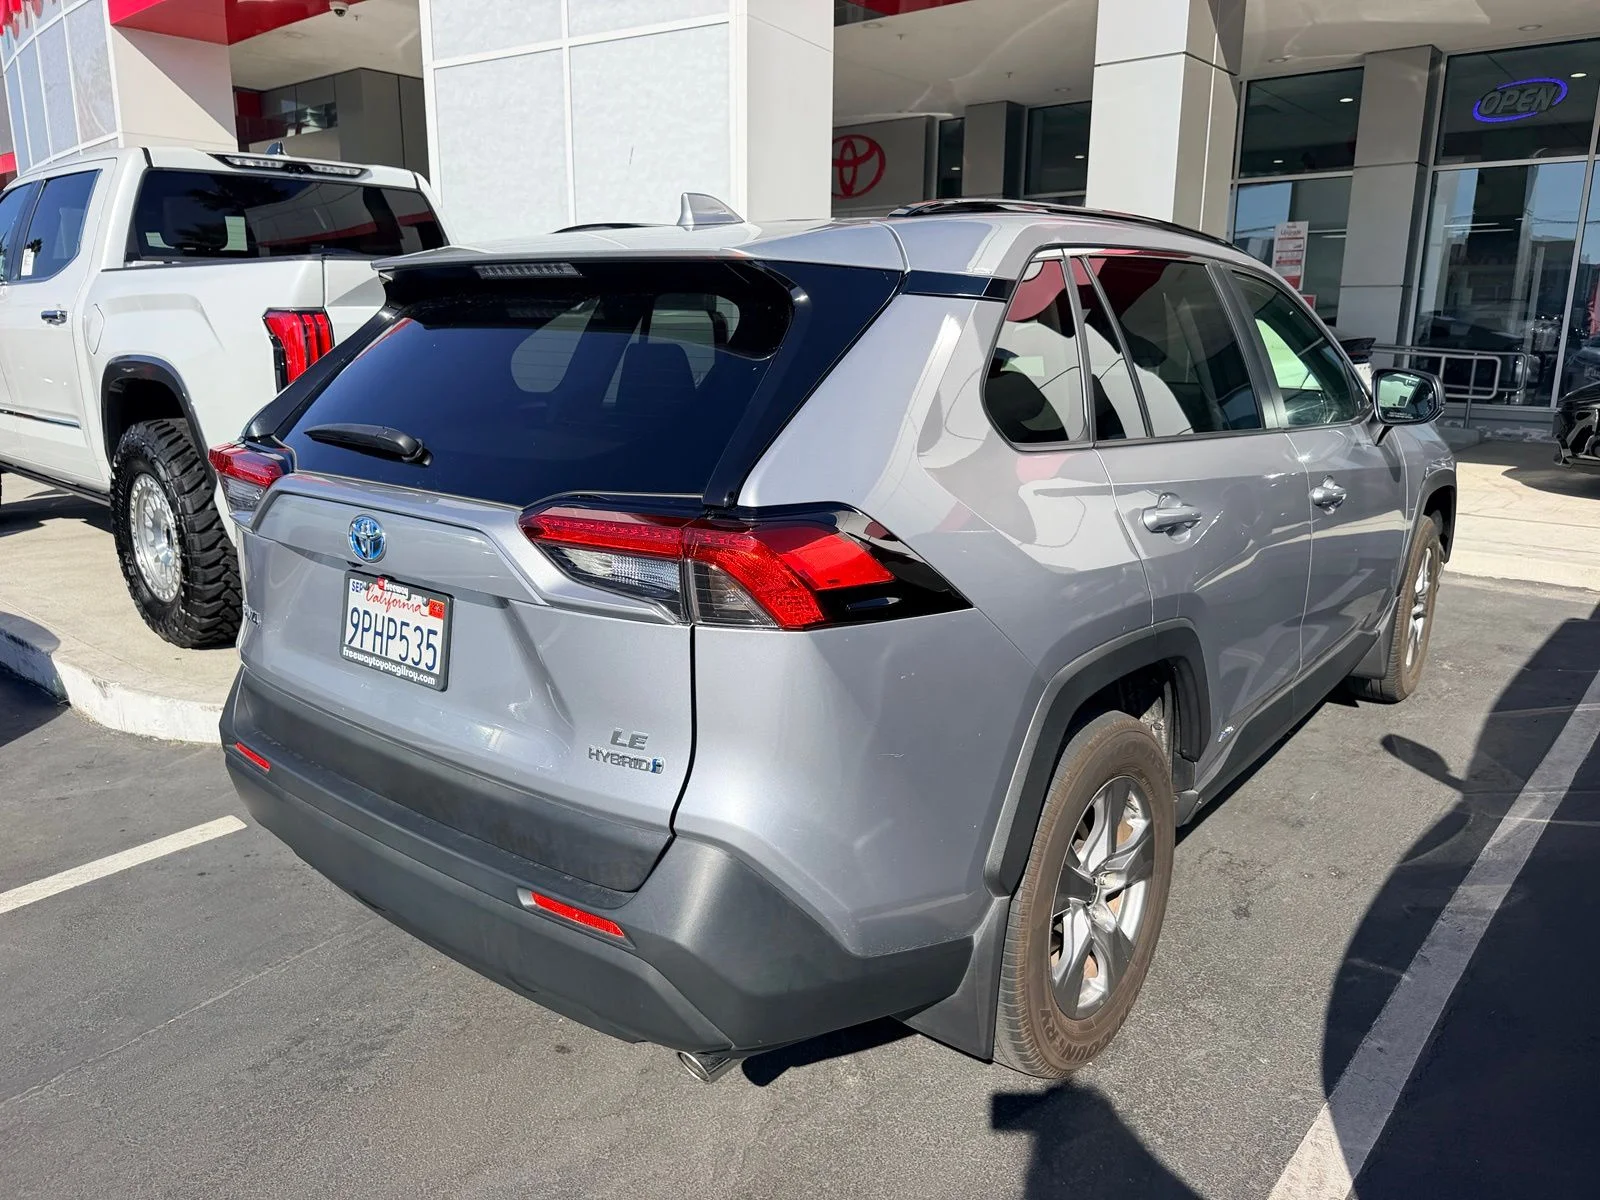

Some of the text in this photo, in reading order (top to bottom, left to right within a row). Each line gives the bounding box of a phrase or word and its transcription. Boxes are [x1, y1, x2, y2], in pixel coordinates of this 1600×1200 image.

[1480, 86, 1558, 115] OPEN
[351, 580, 364, 593] SEP
[365, 583, 428, 617] California
[347, 606, 438, 671] 9PHP535
[343, 646, 436, 686] freewaytoyotagilroy.com
[610, 727, 649, 751] LE
[587, 744, 652, 772] HYBRID
